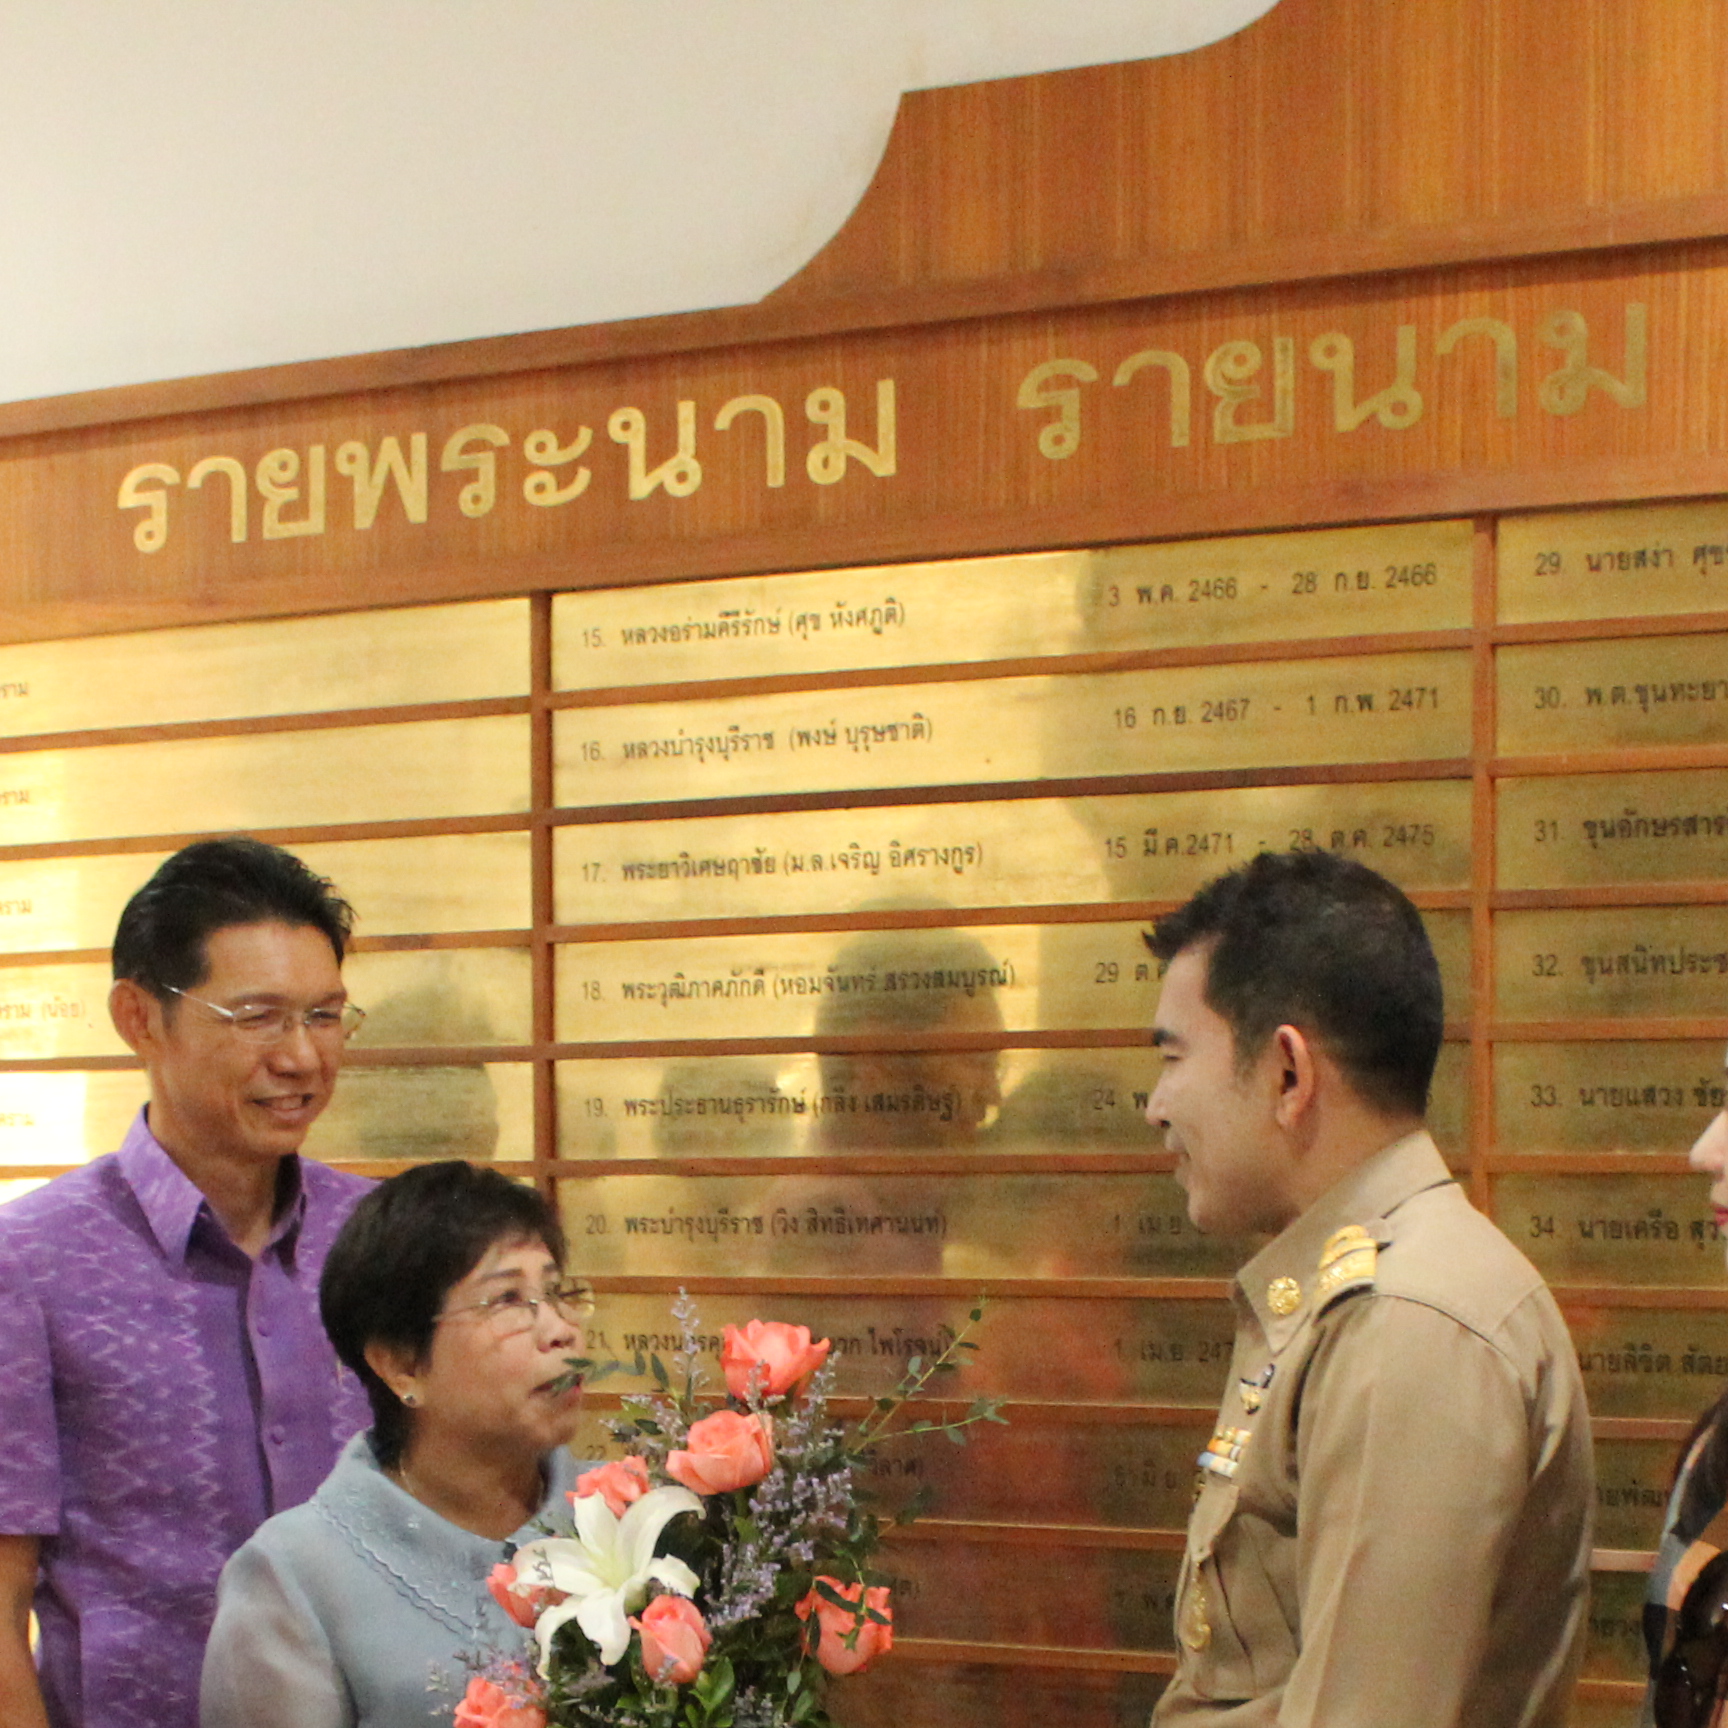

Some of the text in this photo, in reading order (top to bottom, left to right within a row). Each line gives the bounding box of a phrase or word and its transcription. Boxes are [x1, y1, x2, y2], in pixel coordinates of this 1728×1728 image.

[115, 377, 898, 556] รายพระนาม
[1014, 300, 1648, 461] รายนาม
[1108, 584, 1121, 608] 3
[1188, 576, 1238, 603] 2466
[1290, 571, 1318, 596] 28
[1384, 562, 1438, 589] 2466
[581, 628, 607, 649] 15.
[1113, 706, 1137, 730] 16
[1200, 698, 1251, 724] 2467
[1306, 694, 1316, 717] 1
[1387, 687, 1439, 712] 2471
[1534, 685, 1568, 710] 30.
[580, 741, 607, 763] 16.
[1104, 835, 1128, 859] 15
[1381, 823, 1436, 848] 2475
[580, 863, 607, 883] 17.
[1094, 961, 1120, 984] 29
[1531, 952, 1564, 978] 32.
[580, 980, 606, 1001] 18.
[583, 1097, 608, 1118] 19.
[1530, 1083, 1563, 1108] 33.
[584, 1214, 610, 1236] 20.
